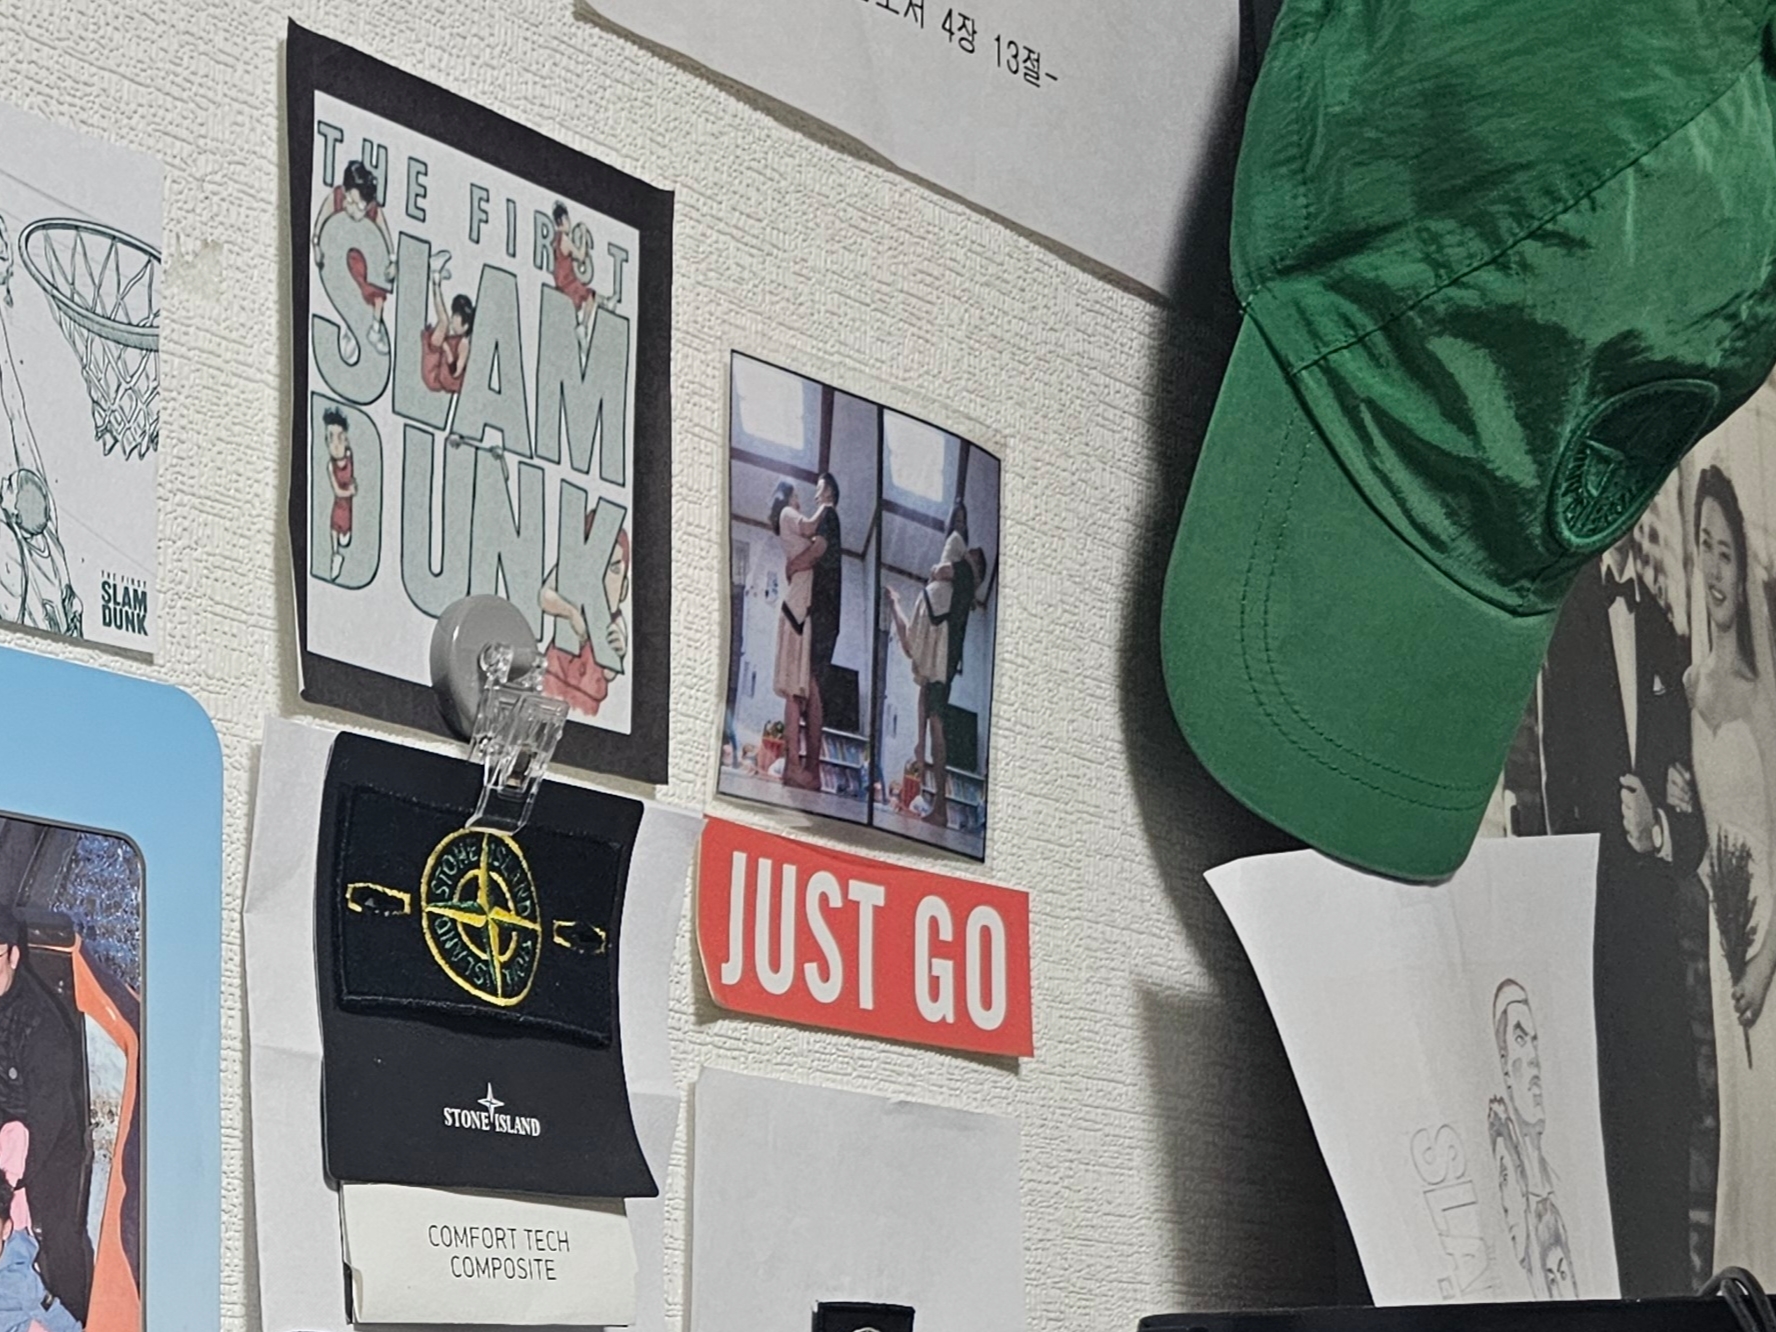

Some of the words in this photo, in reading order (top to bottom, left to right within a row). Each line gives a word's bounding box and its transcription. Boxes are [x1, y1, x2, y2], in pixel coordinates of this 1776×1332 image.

[941, 8, 977, 54] 4장
[994, 33, 1058, 88] 13절-
[316, 119, 430, 225] THE
[467, 183, 630, 308] FIRST
[310, 212, 633, 488] SLAM
[309, 390, 630, 676] DUNK
[101, 580, 147, 614] SLAM
[101, 604, 149, 637] DUNK
[720, 849, 886, 1011] JUST
[914, 893, 1008, 1032] GO
[443, 1106, 490, 1131] STONE
[493, 1112, 541, 1137] ISLAND
[428, 1225, 517, 1252] COMFORT
[524, 1229, 570, 1253] TECH
[1410, 1122, 1492, 1300] SLA
[450, 1255, 557, 1282] COMPOSITE
